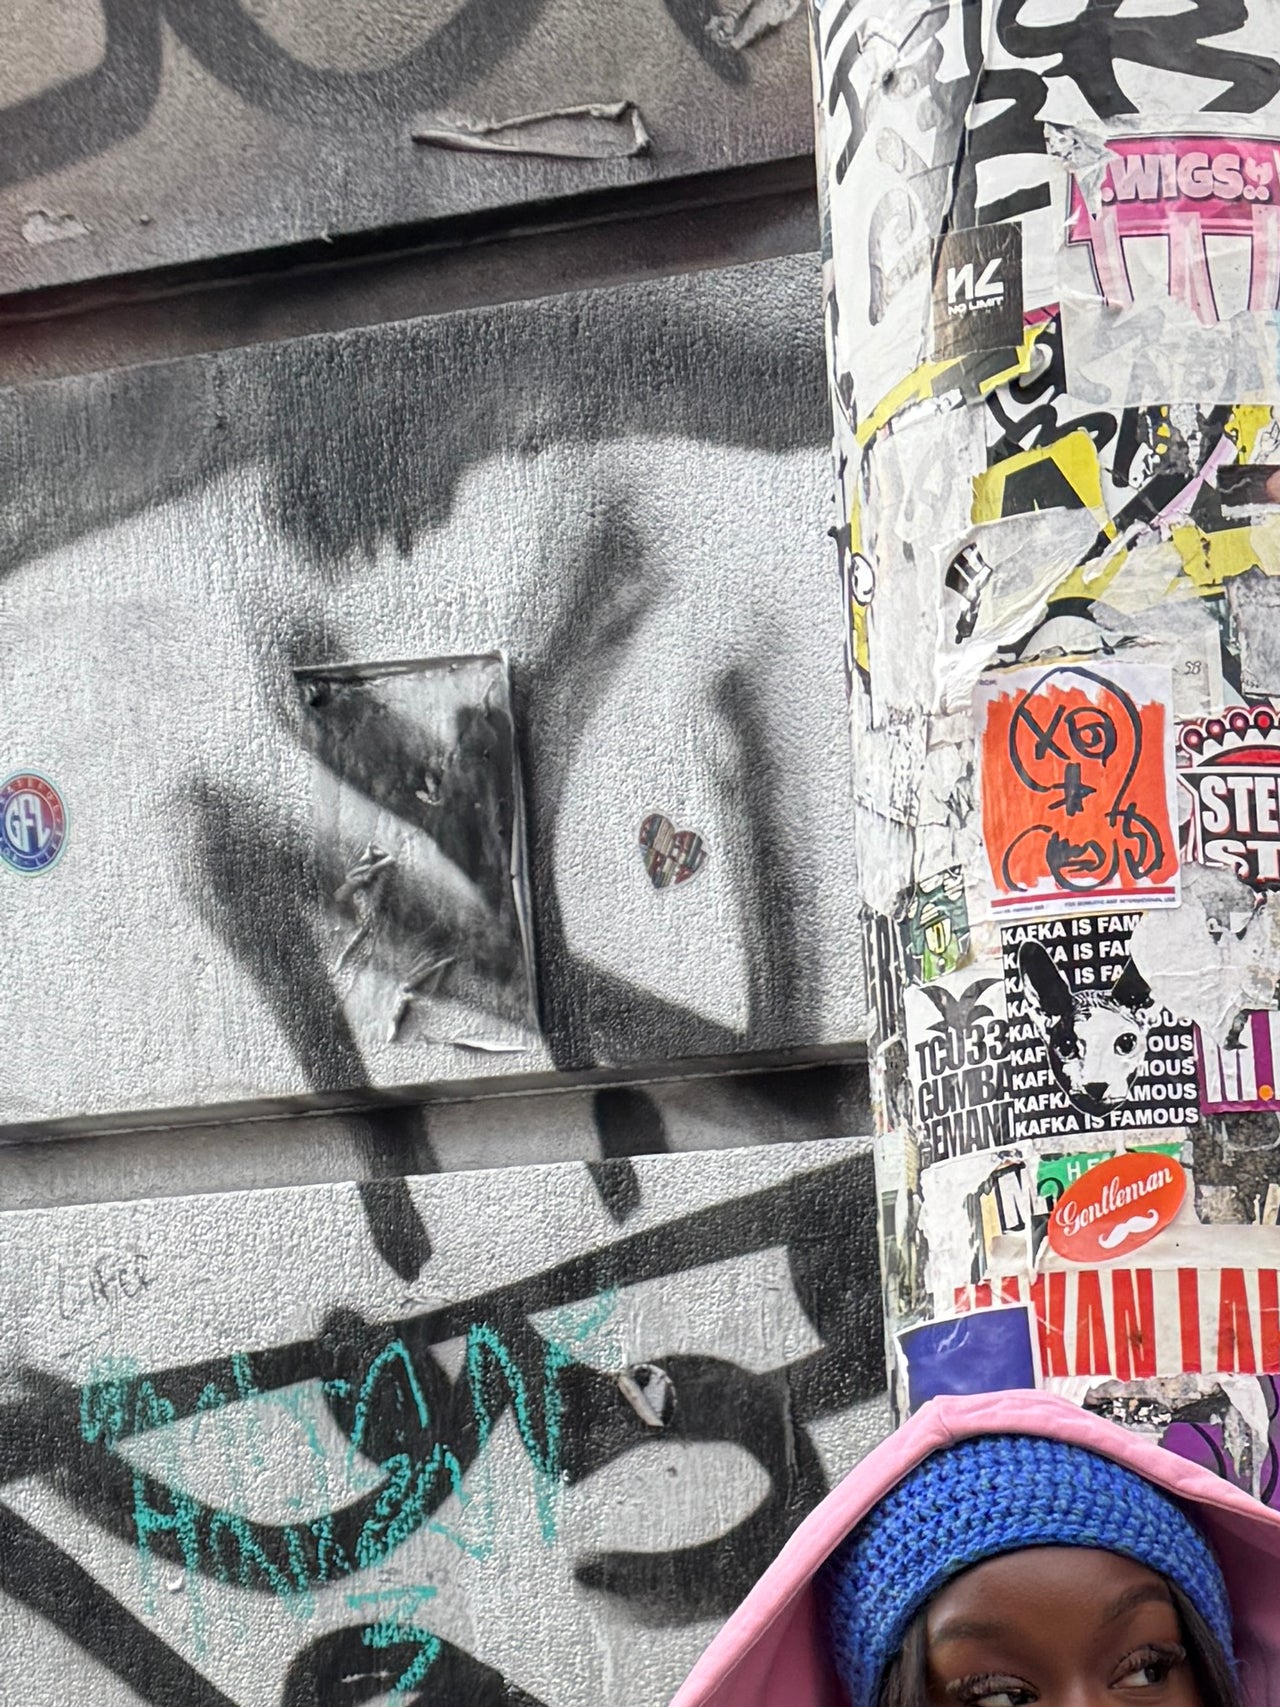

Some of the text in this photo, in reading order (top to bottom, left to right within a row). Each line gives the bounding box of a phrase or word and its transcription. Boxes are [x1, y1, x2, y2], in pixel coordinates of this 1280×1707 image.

[948, 296, 1004, 316] NO LIMIT
[1002, 915, 1141, 946] KAFKA IS FAM
[1074, 943, 1094, 960] IS
[1075, 967, 1095, 984] IS
[1015, 1108, 1199, 1138] KAFKA IS FAMOUS
[1056, 1167, 1173, 1237] Gentleman
